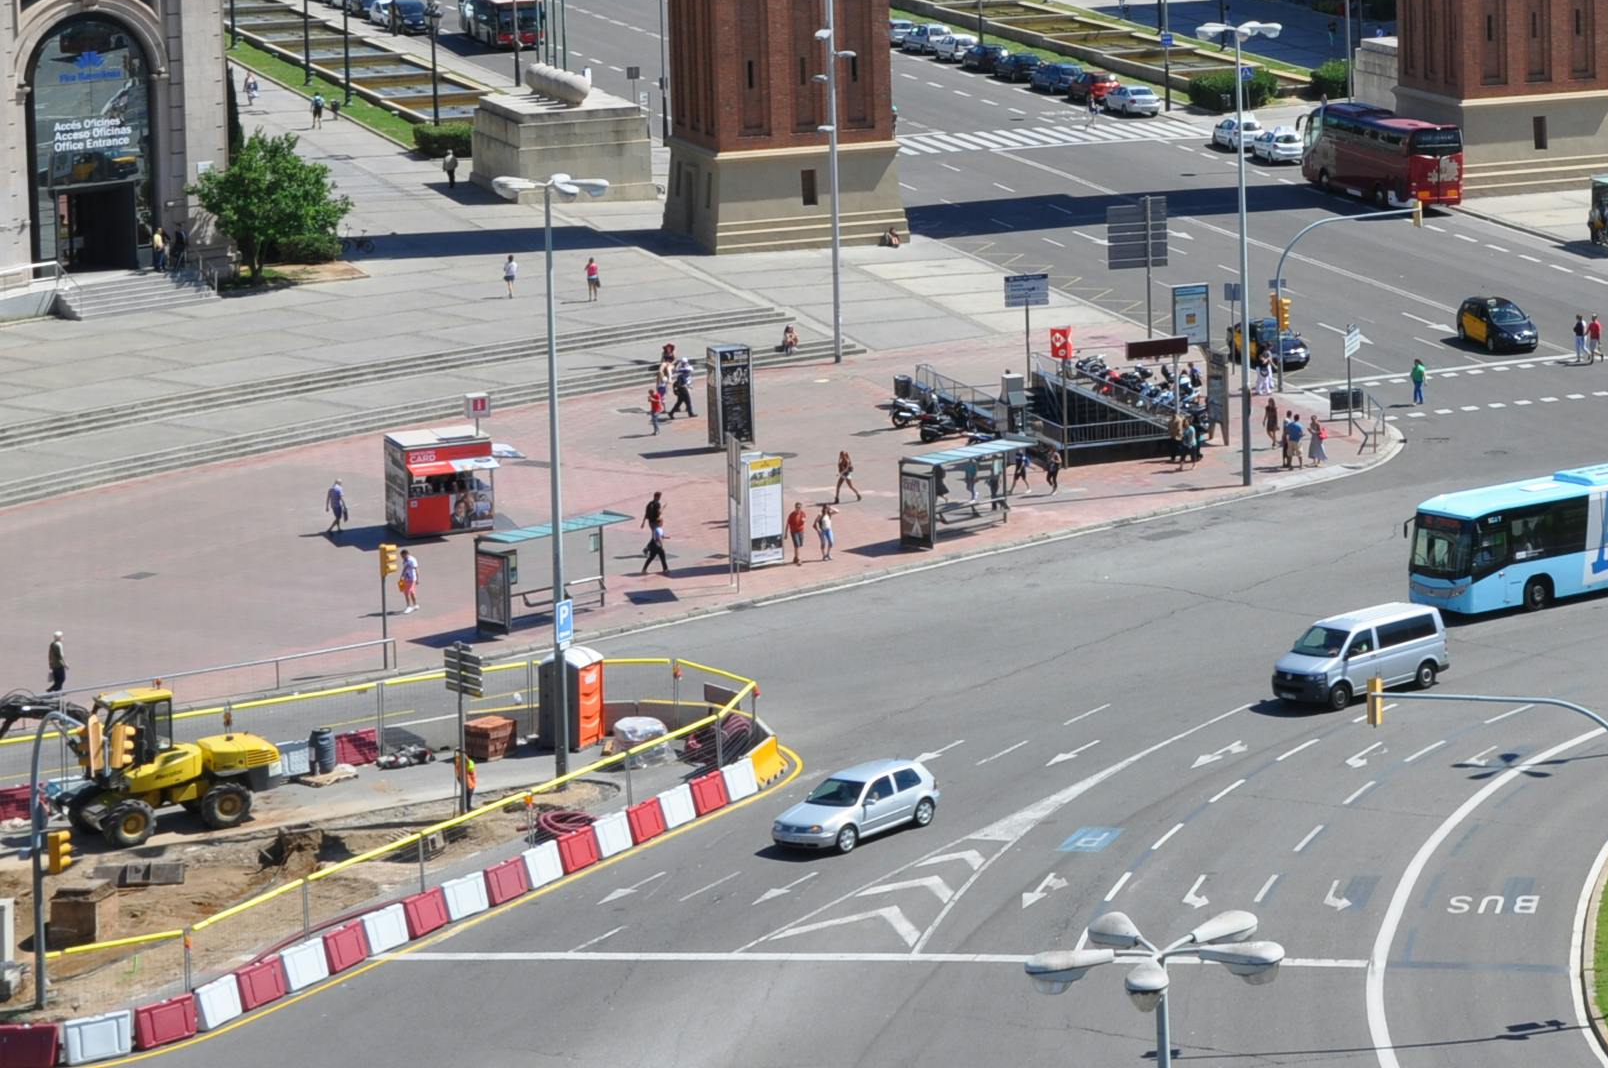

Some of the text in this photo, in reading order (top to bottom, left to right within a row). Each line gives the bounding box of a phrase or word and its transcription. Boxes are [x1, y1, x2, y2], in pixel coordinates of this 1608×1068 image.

[83, 117, 121, 128] Oficines
[54, 126, 132, 141] Acceso Oficinas
[54, 136, 130, 152] Office Entrance
[409, 454, 436, 463] CARD
[559, 605, 569, 626] P
[1446, 895, 1541, 914] BUS
